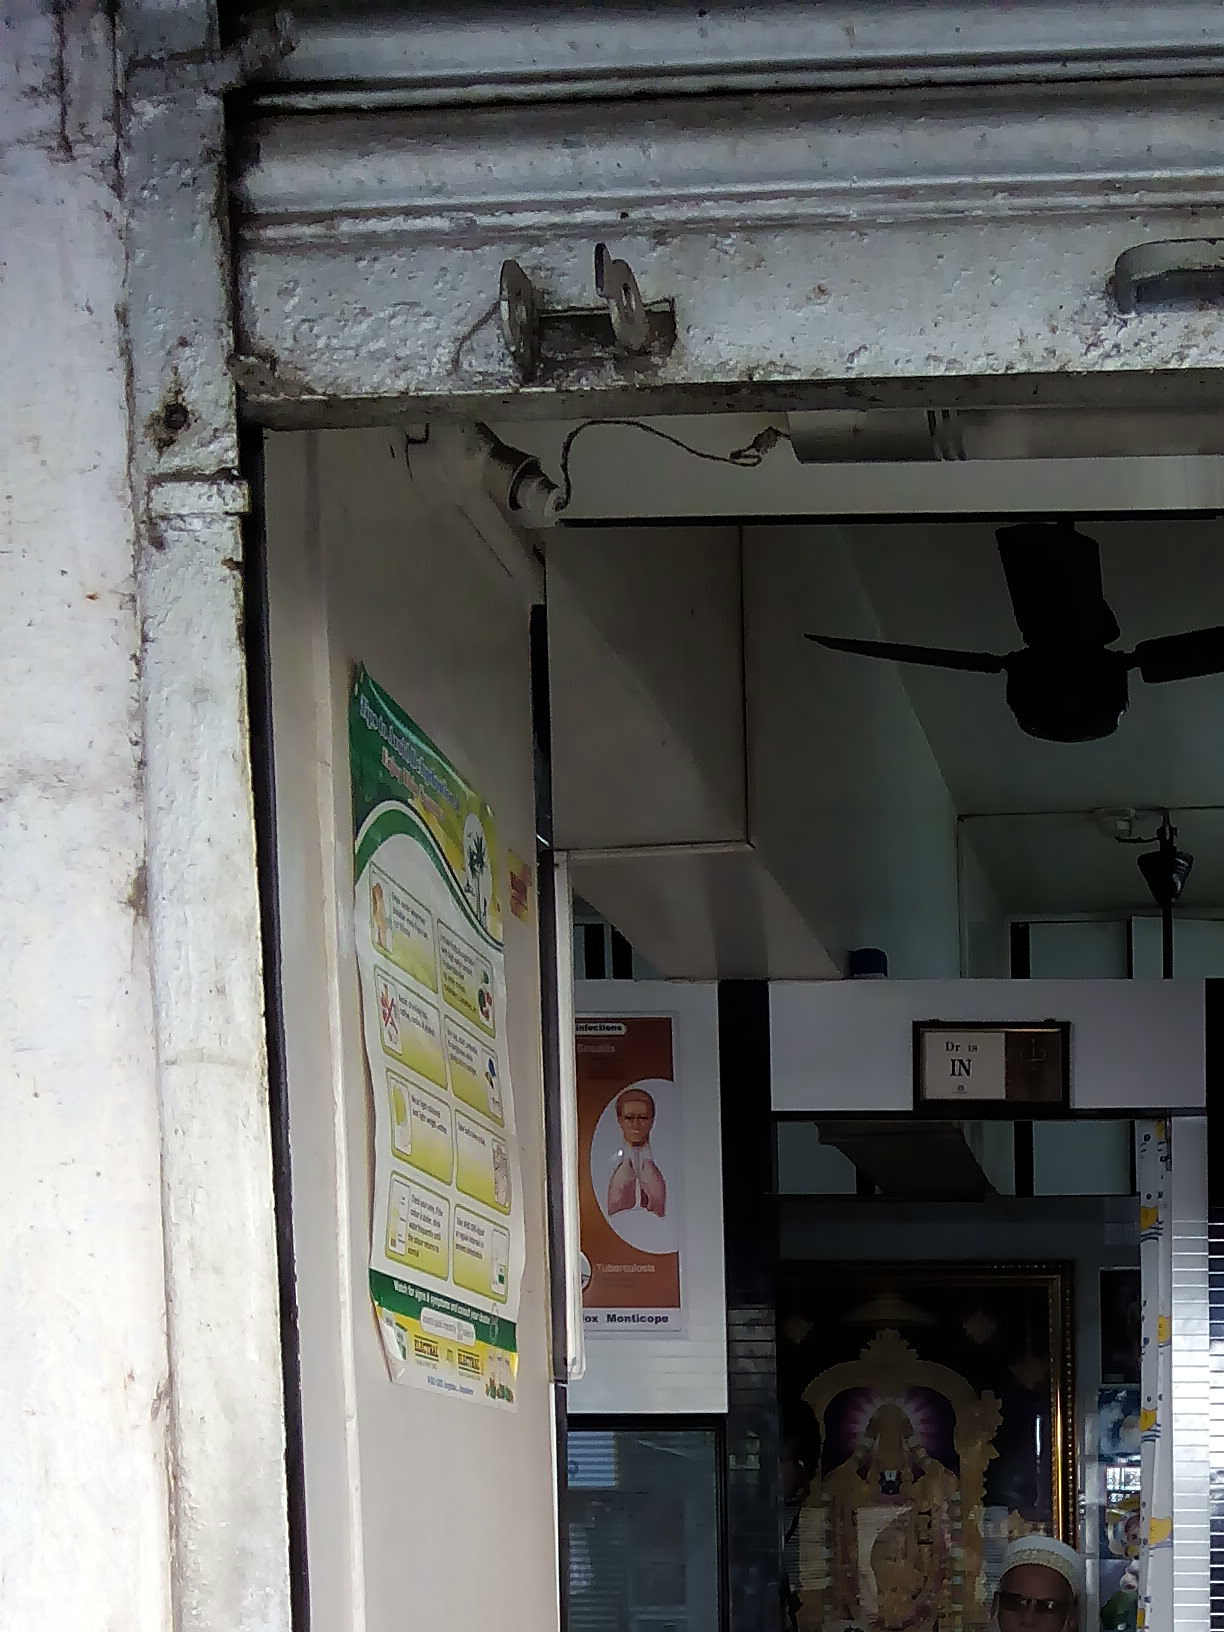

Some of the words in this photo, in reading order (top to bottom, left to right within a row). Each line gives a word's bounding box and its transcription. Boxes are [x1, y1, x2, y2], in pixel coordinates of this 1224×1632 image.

[945, 1041, 961, 1052] Dr
[950, 1058, 972, 1077] IN
[583, 1314, 599, 1324] ox
[606, 1312, 669, 1326] Monticope
